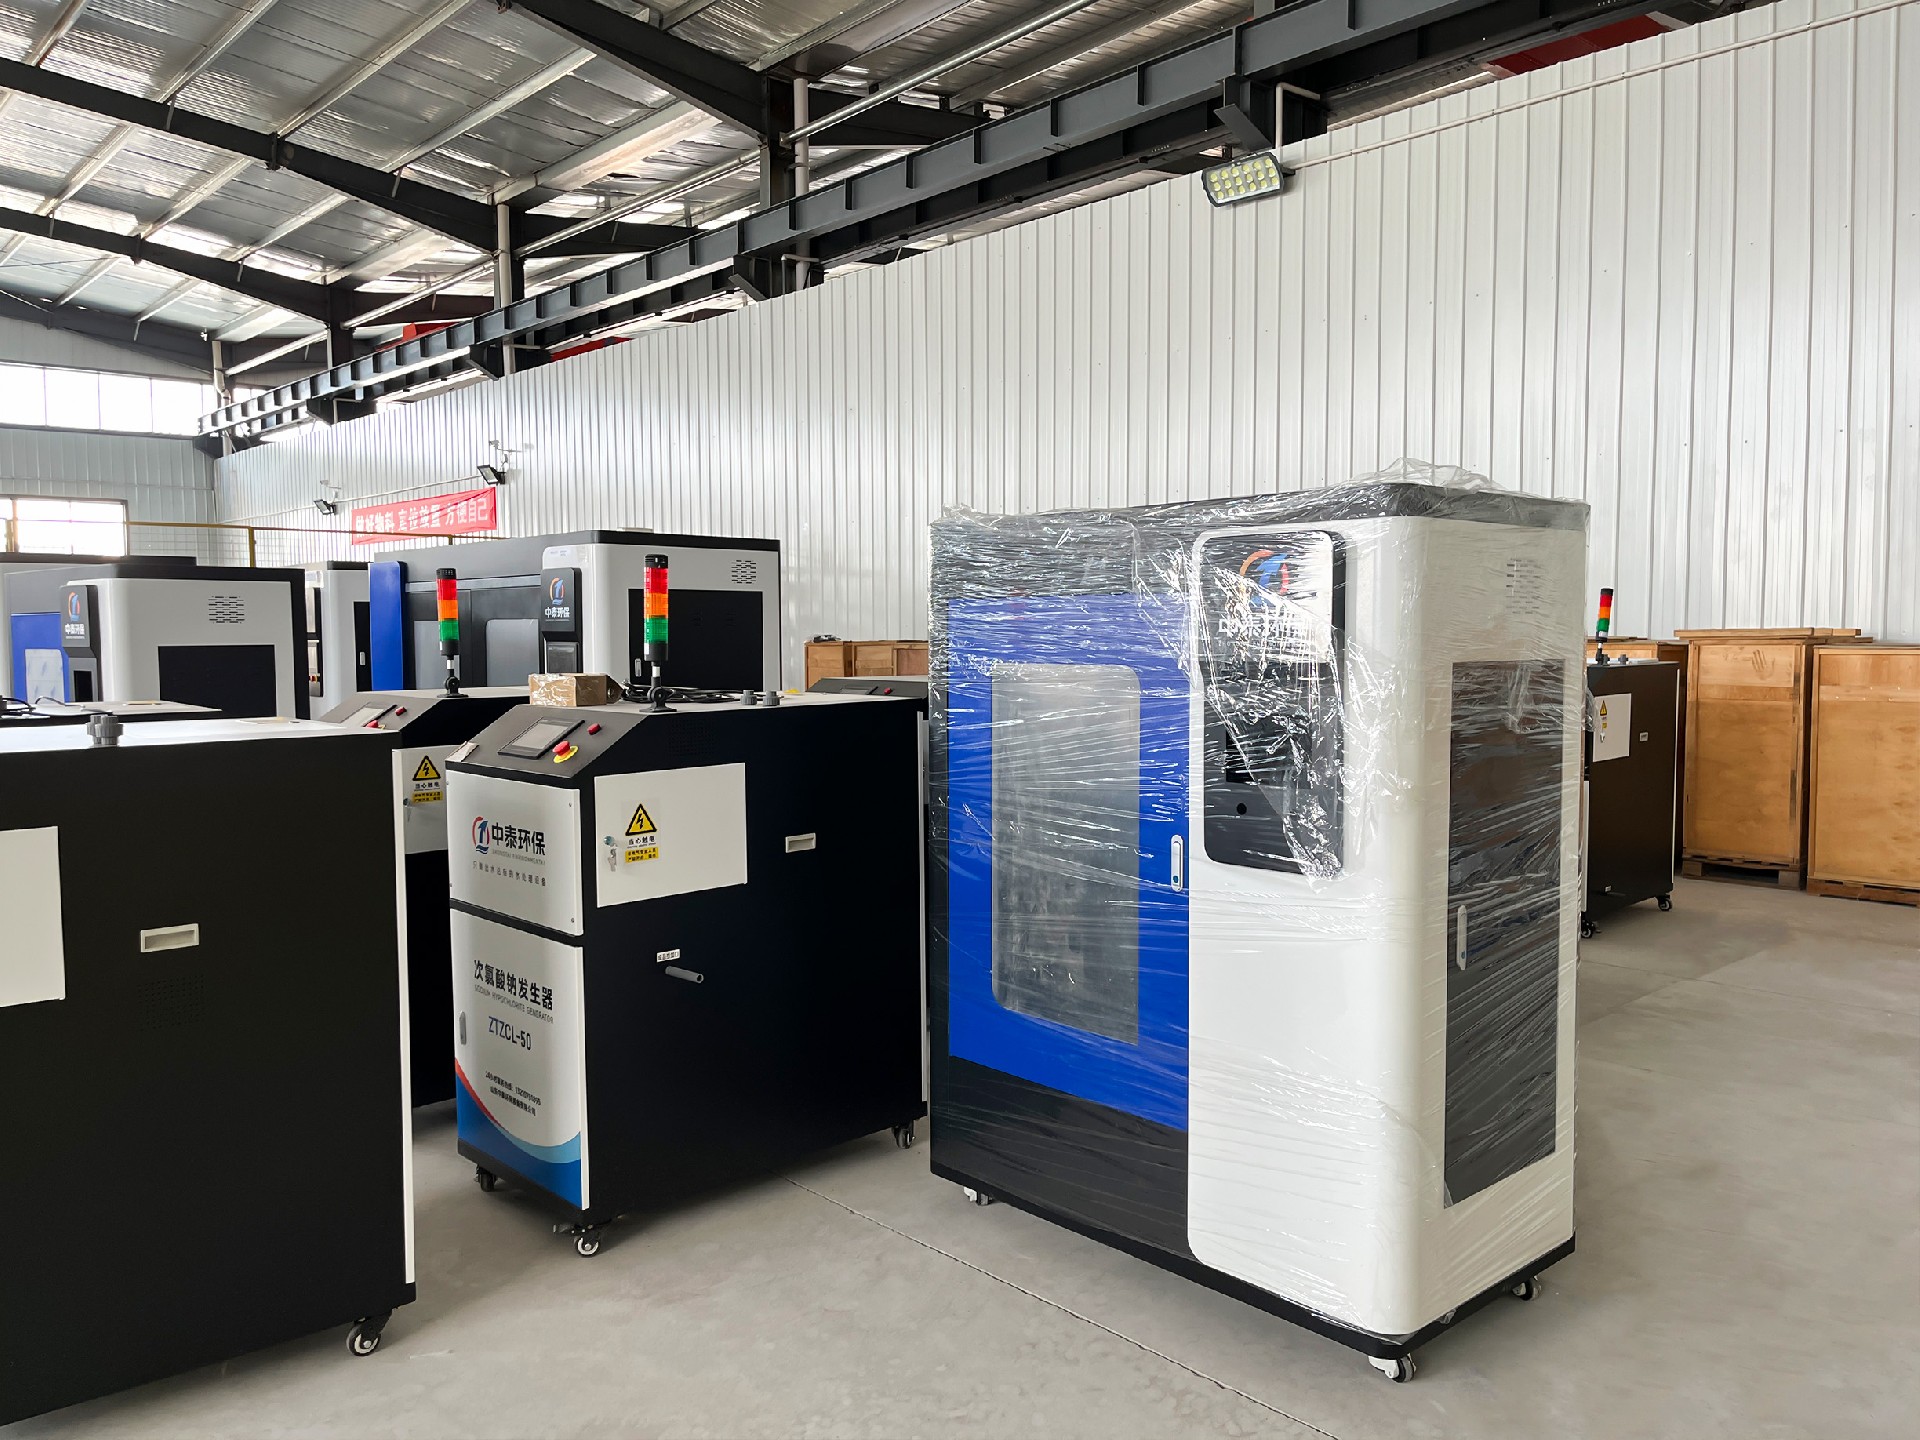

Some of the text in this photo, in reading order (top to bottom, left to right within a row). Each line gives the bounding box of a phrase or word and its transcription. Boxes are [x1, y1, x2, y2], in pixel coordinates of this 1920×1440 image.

[445, 497, 488, 526] 方便自己
[491, 821, 546, 856] 中泰环保
[474, 959, 553, 1011] 次氯酸钠发生器
[488, 1015, 531, 1051] ZTZCL-50
